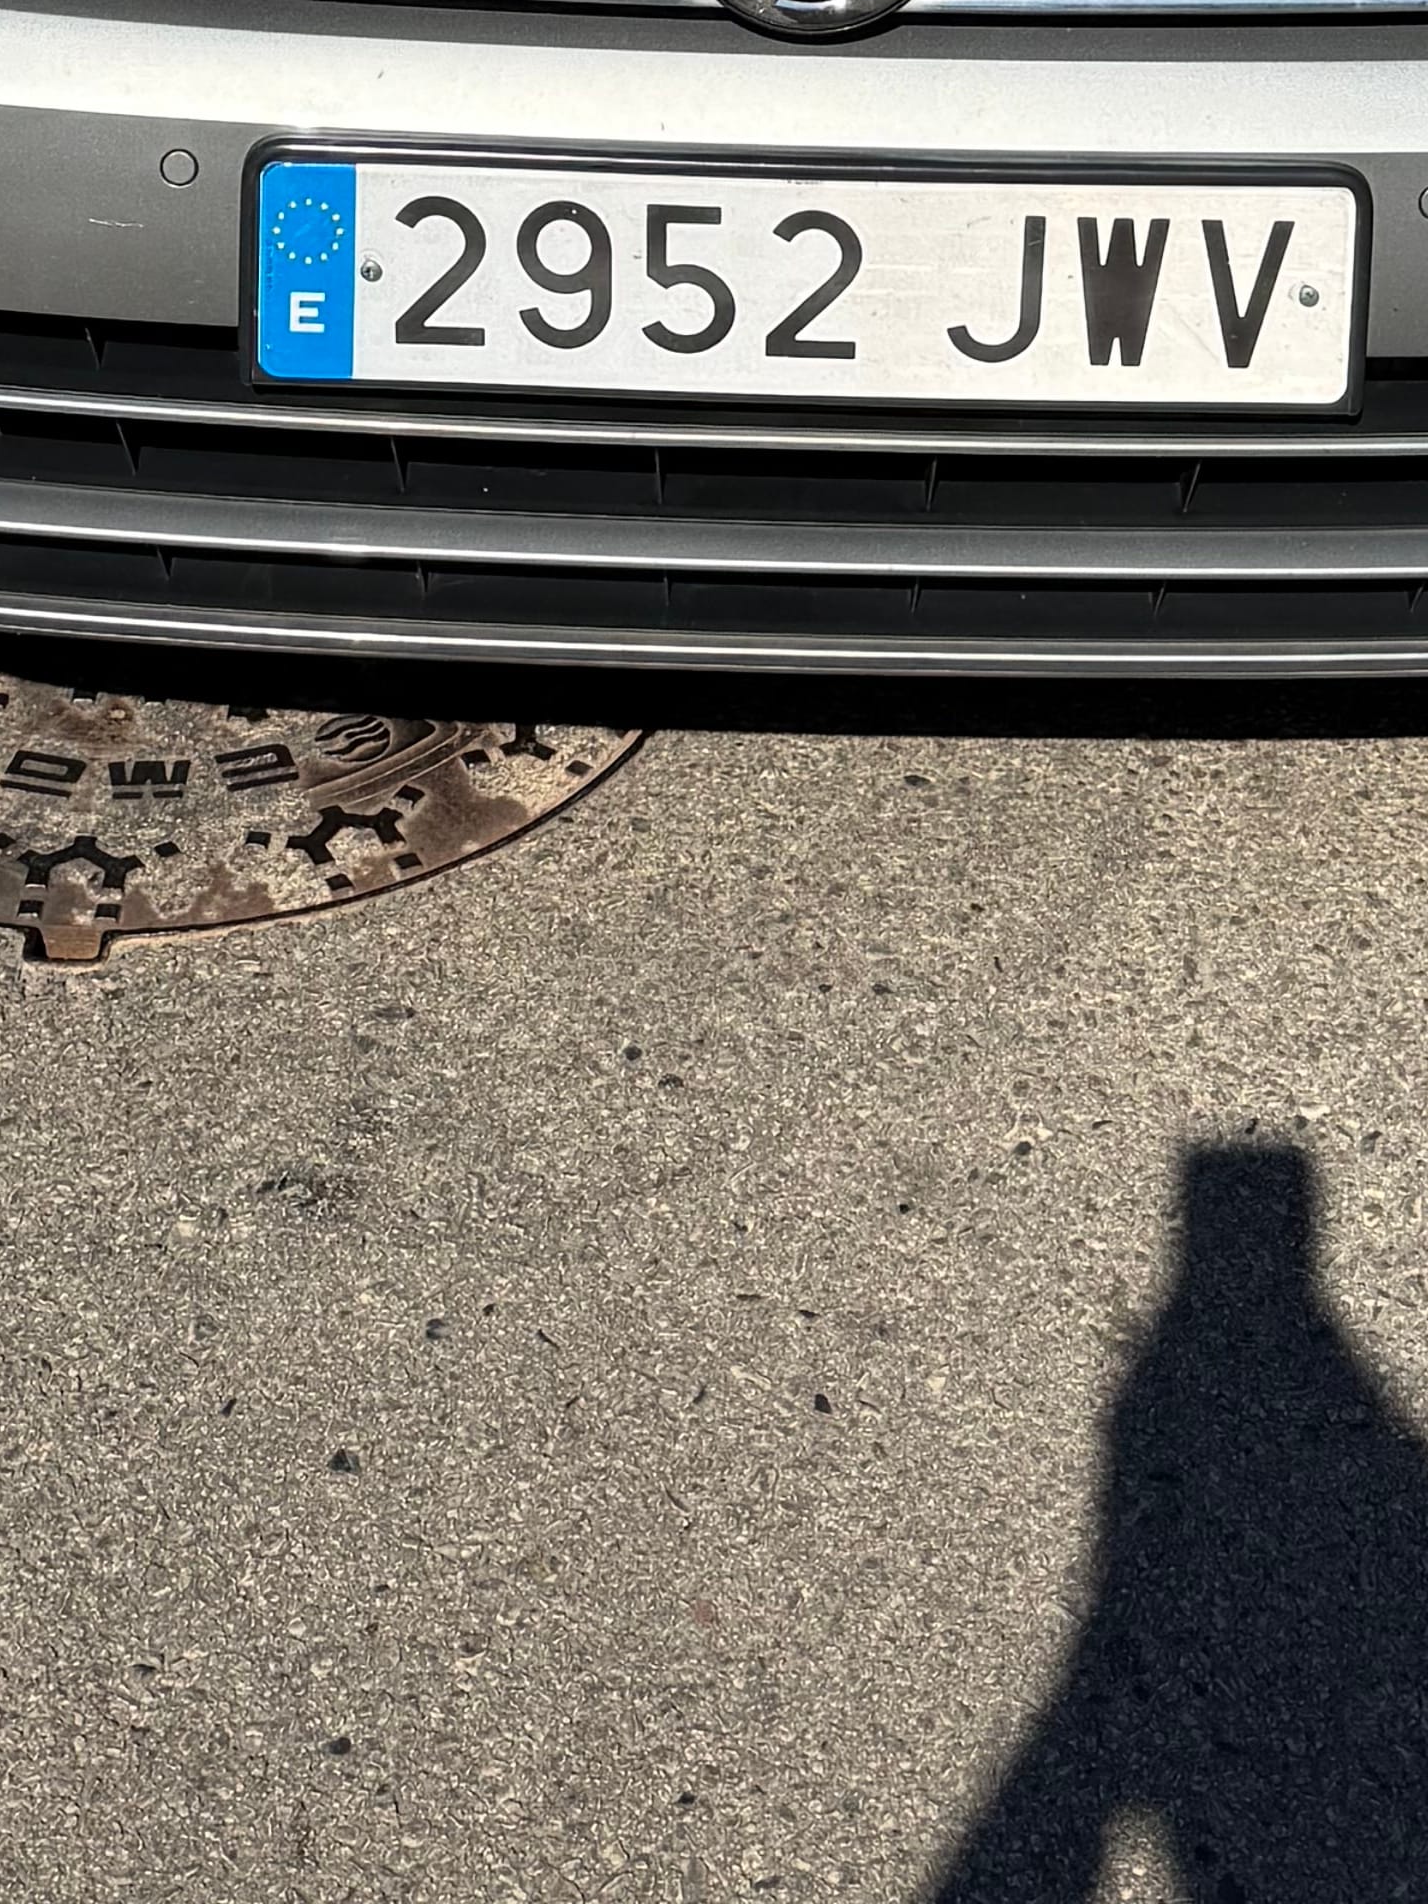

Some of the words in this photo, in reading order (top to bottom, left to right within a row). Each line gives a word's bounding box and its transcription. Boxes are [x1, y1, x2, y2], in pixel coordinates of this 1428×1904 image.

[290, 291, 326, 334] E
[392, 195, 864, 362] 2952
[946, 214, 1297, 370] JWV
